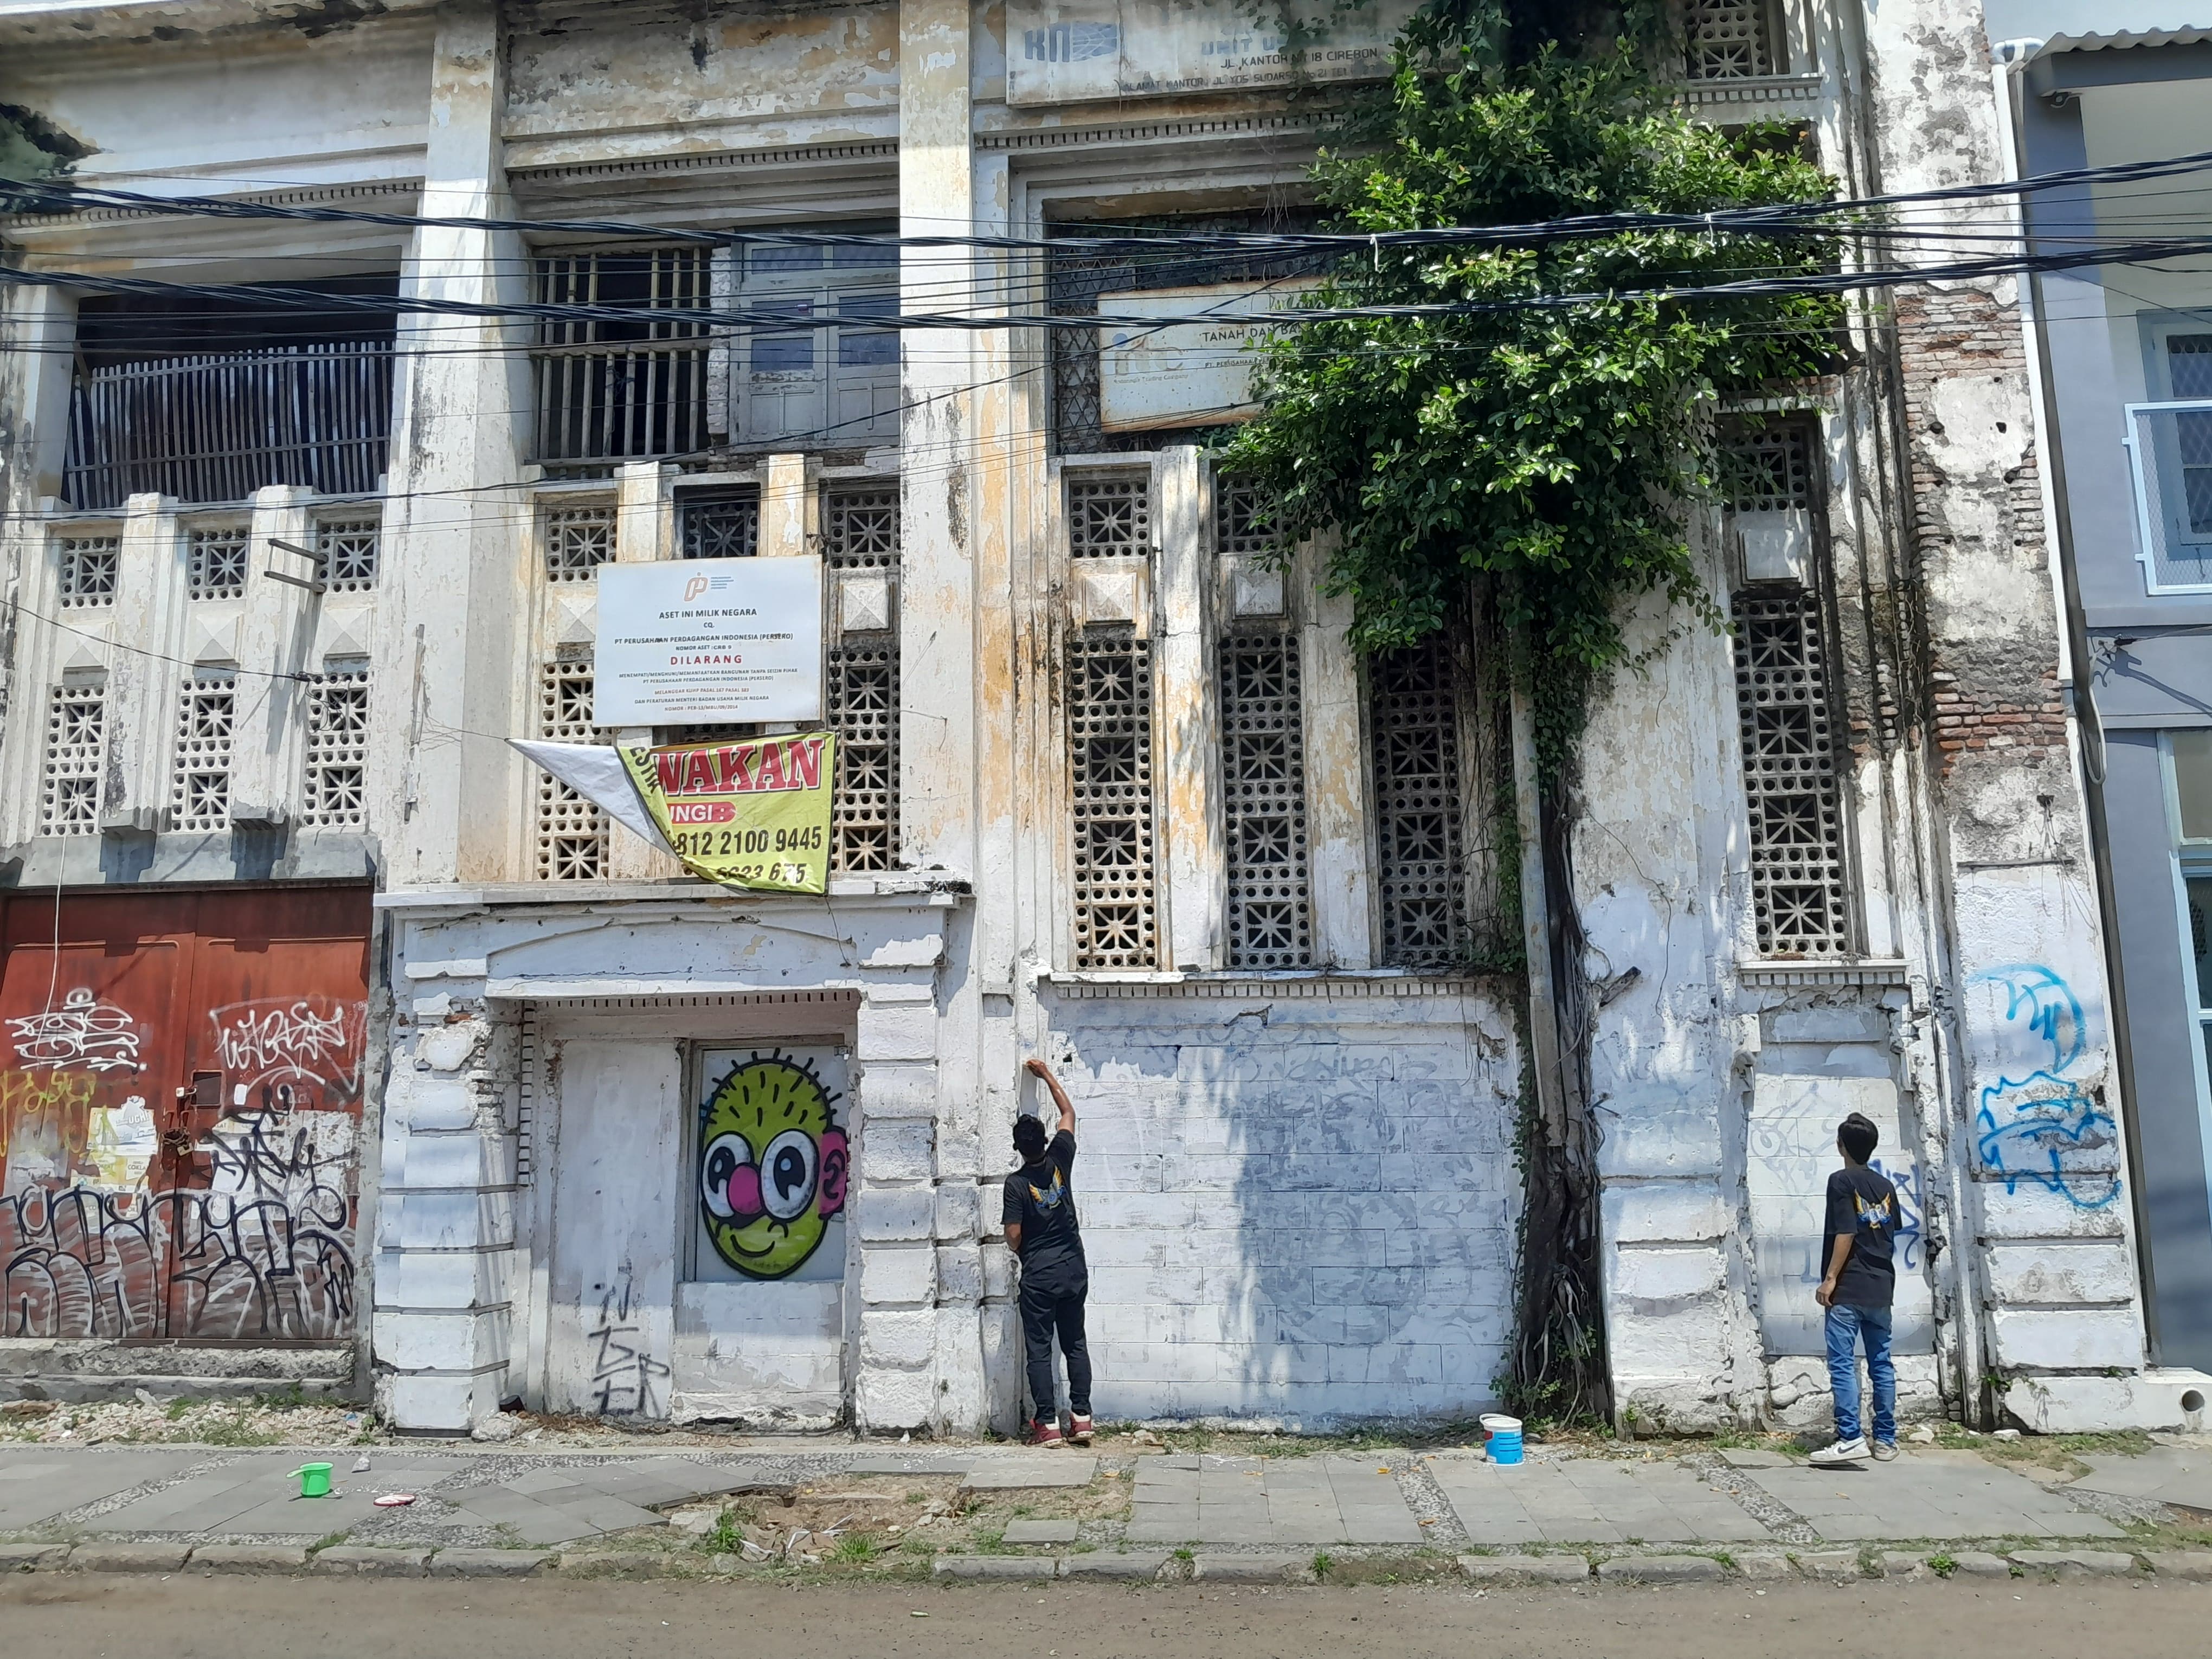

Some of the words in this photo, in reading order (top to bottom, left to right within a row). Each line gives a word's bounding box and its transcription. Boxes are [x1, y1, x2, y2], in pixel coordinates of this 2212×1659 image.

[1242, 54, 1288, 66] KANTOR
[1312, 53, 1322, 62] 18
[1327, 48, 1378, 61] CIREBON
[1203, 329, 1245, 342] TANAH
[722, 608, 757, 616] NEGARA
[670, 655, 742, 665] DILARANG
[719, 829, 769, 855] 2100
[776, 826, 822, 853] 9445
